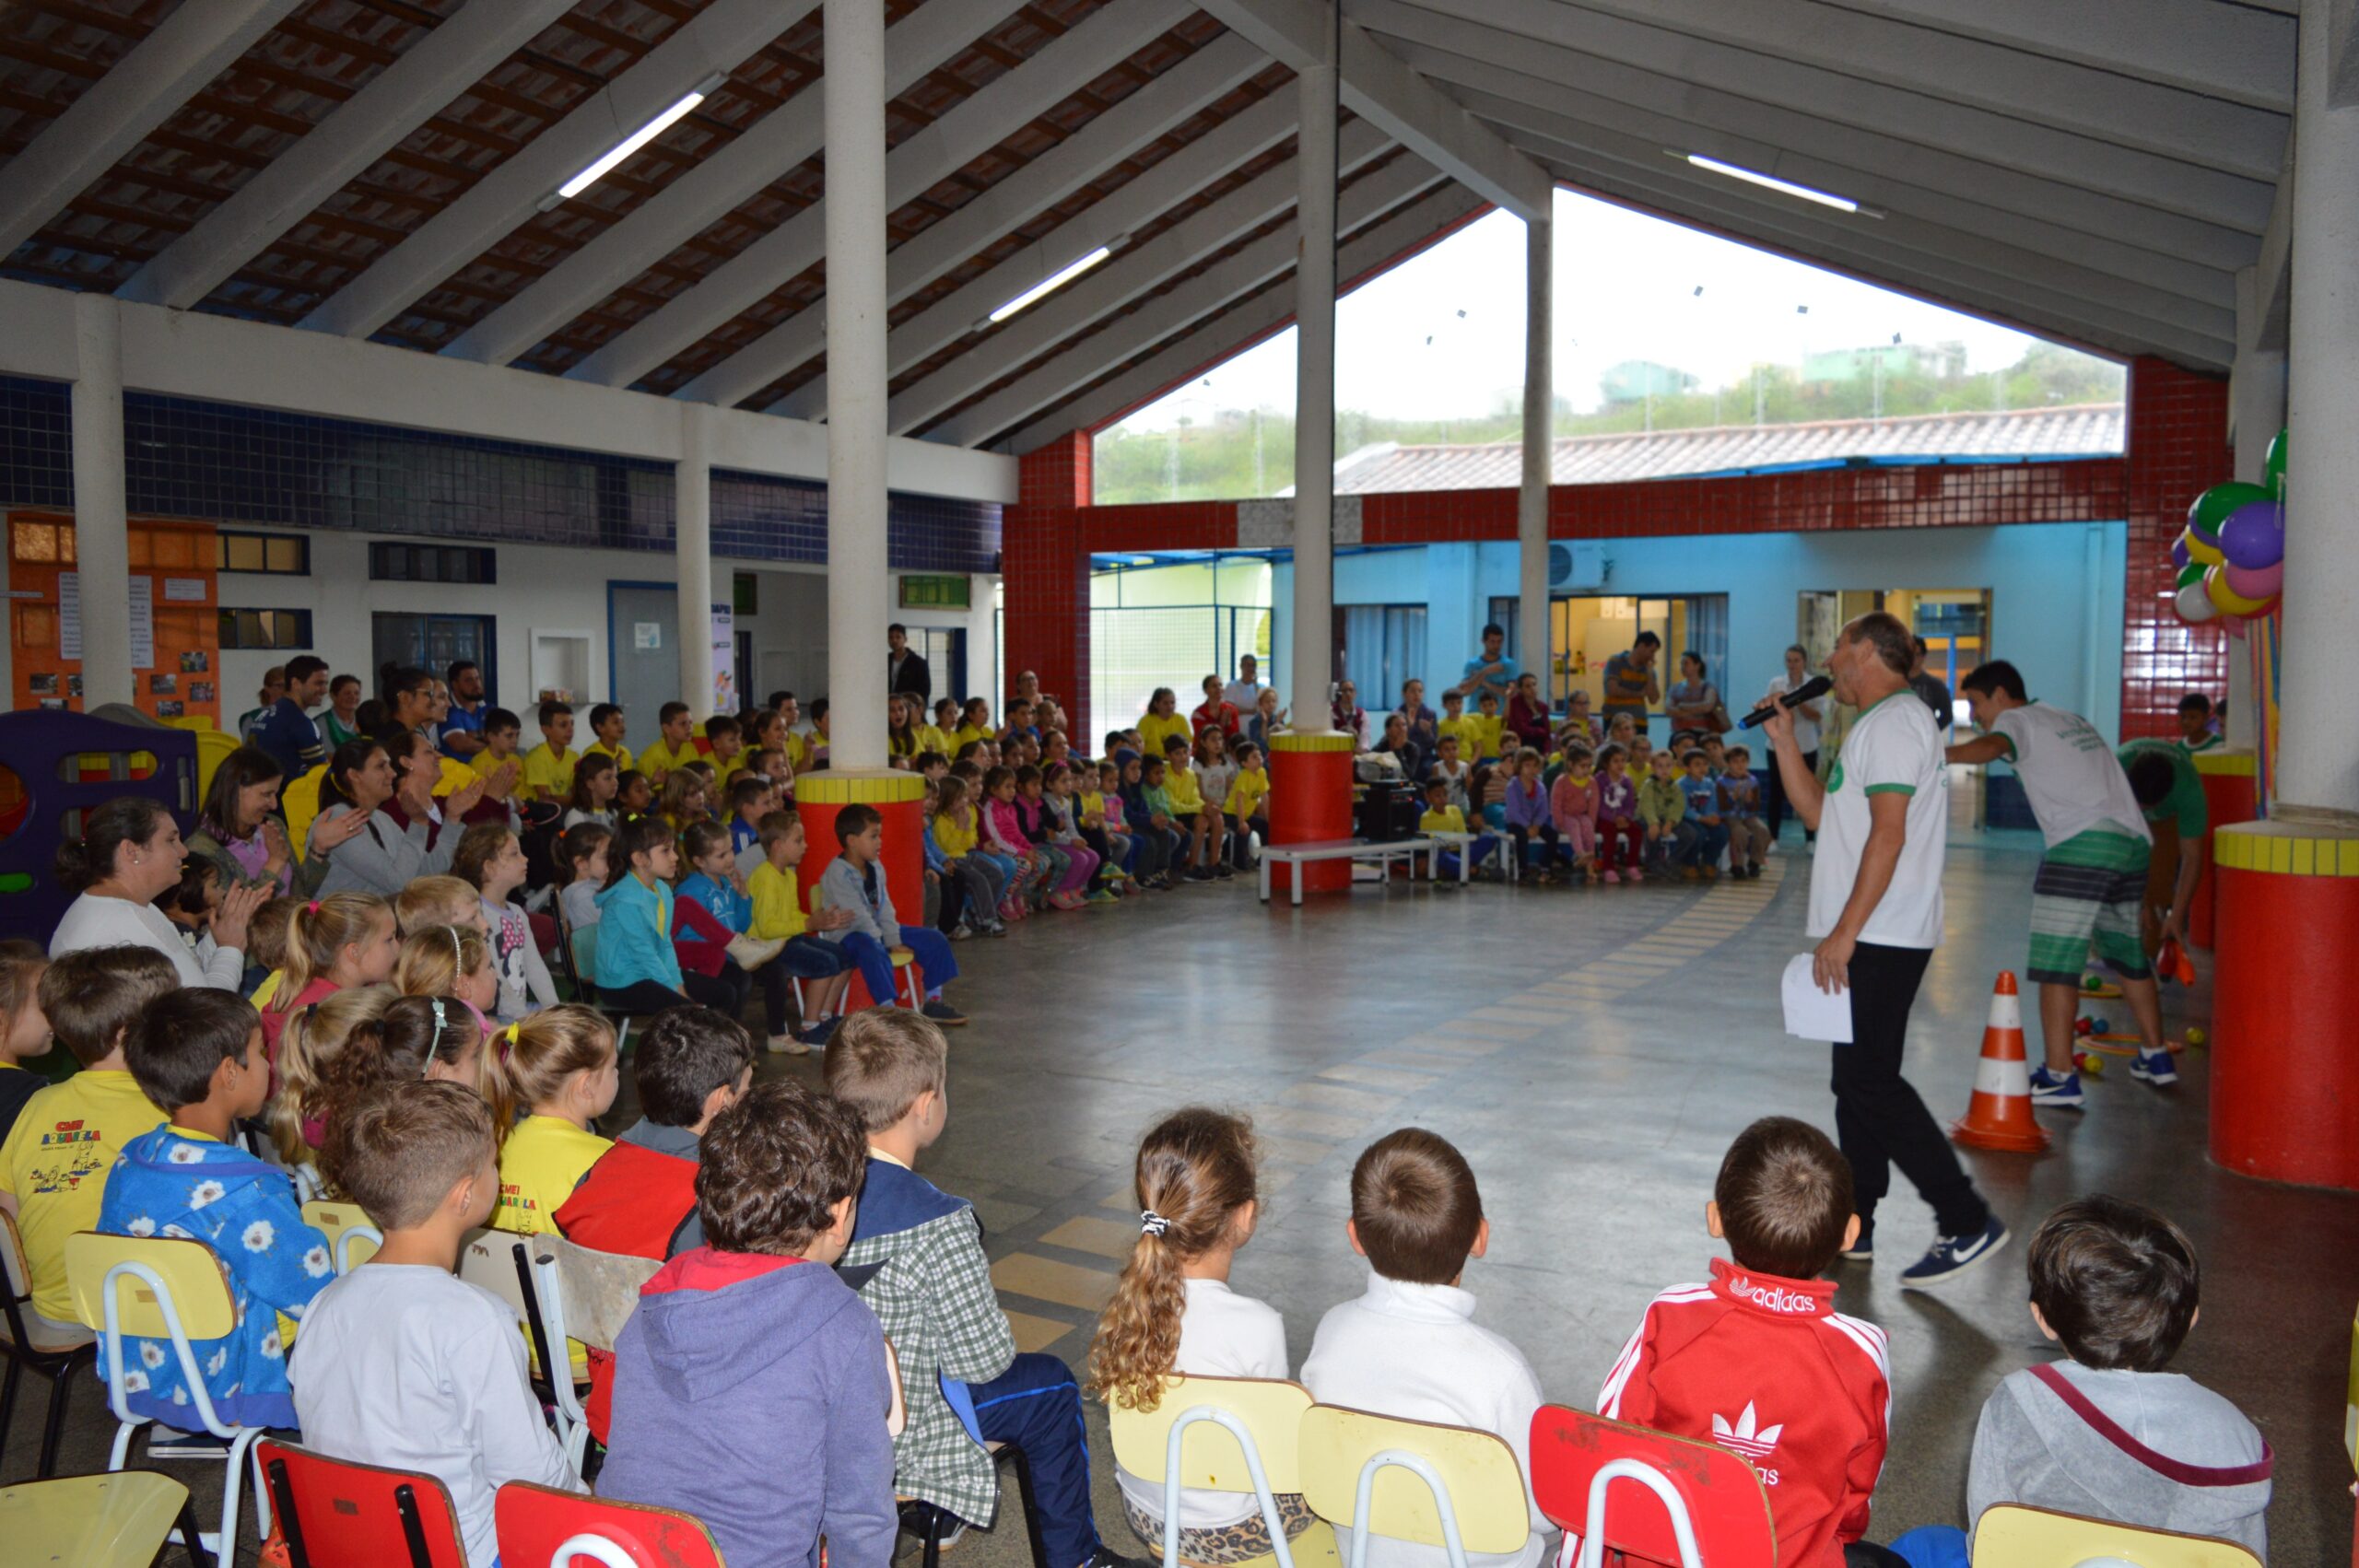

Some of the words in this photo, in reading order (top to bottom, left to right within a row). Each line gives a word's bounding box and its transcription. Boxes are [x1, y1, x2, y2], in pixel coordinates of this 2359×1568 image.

[55, 1119, 85, 1132] CMEI
[41, 1129, 100, 1145] AQUARELA
[500, 1192, 537, 1211] UARLA
[1752, 1287, 1815, 1312] adidas
